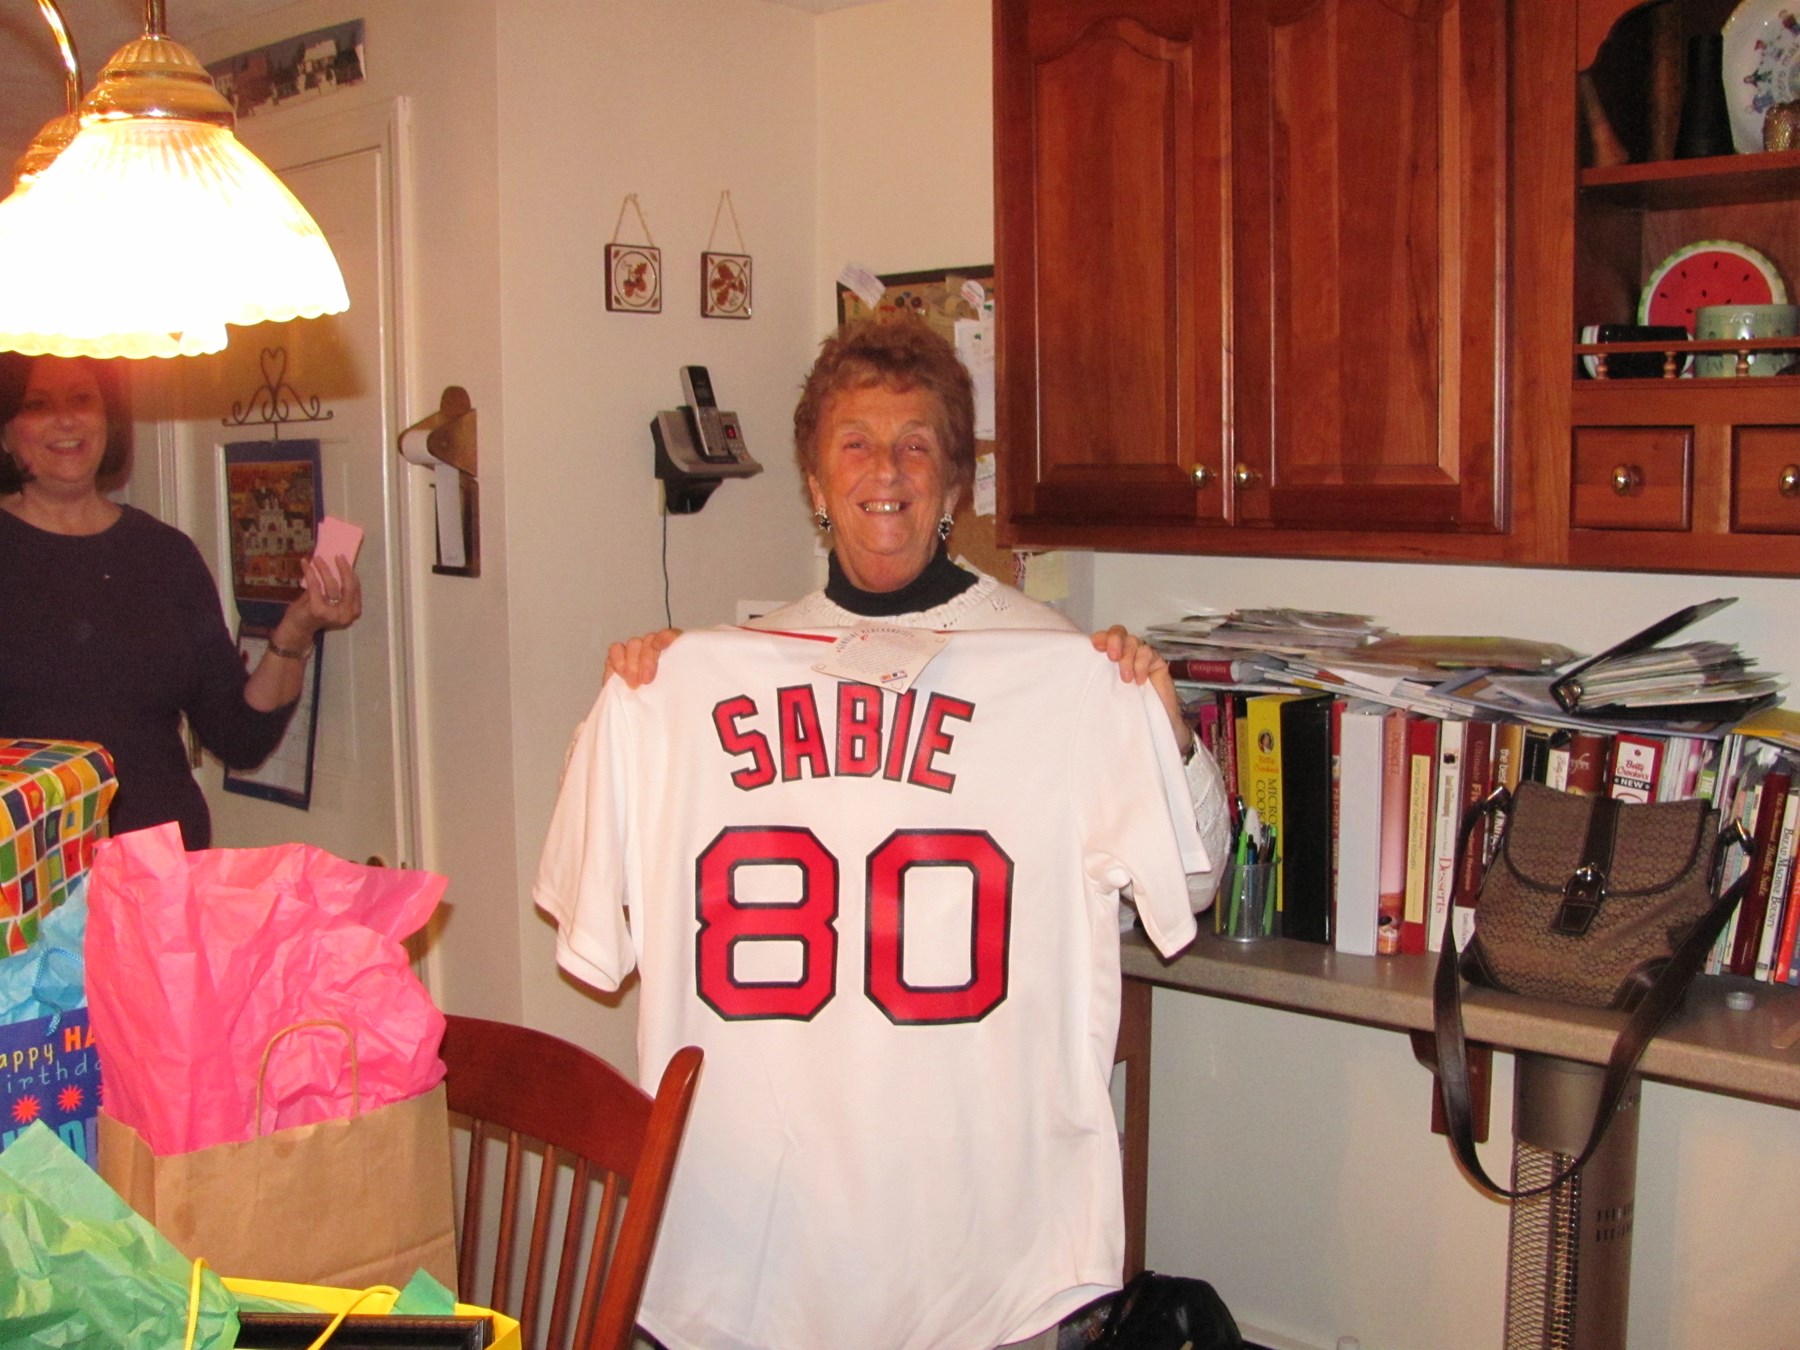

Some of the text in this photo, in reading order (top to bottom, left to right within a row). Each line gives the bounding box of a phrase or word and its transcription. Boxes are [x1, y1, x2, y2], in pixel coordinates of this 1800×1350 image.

[712, 681, 976, 794] SABIE
[1498, 749, 1510, 783] the best
[1620, 778, 1644, 790] NEW
[1626, 759, 1645, 772] Betty
[1256, 780, 1266, 822] COOK
[1268, 779, 1278, 828] MICRO
[1470, 783, 1482, 802] Fiv
[1763, 844, 1776, 872] Bake
[1436, 857, 1452, 914] Desserts
[1758, 873, 1771, 897] Sale
[1766, 828, 1793, 929] BREAD MACHINE BOUNTY
[695, 825, 1015, 1026] 80
